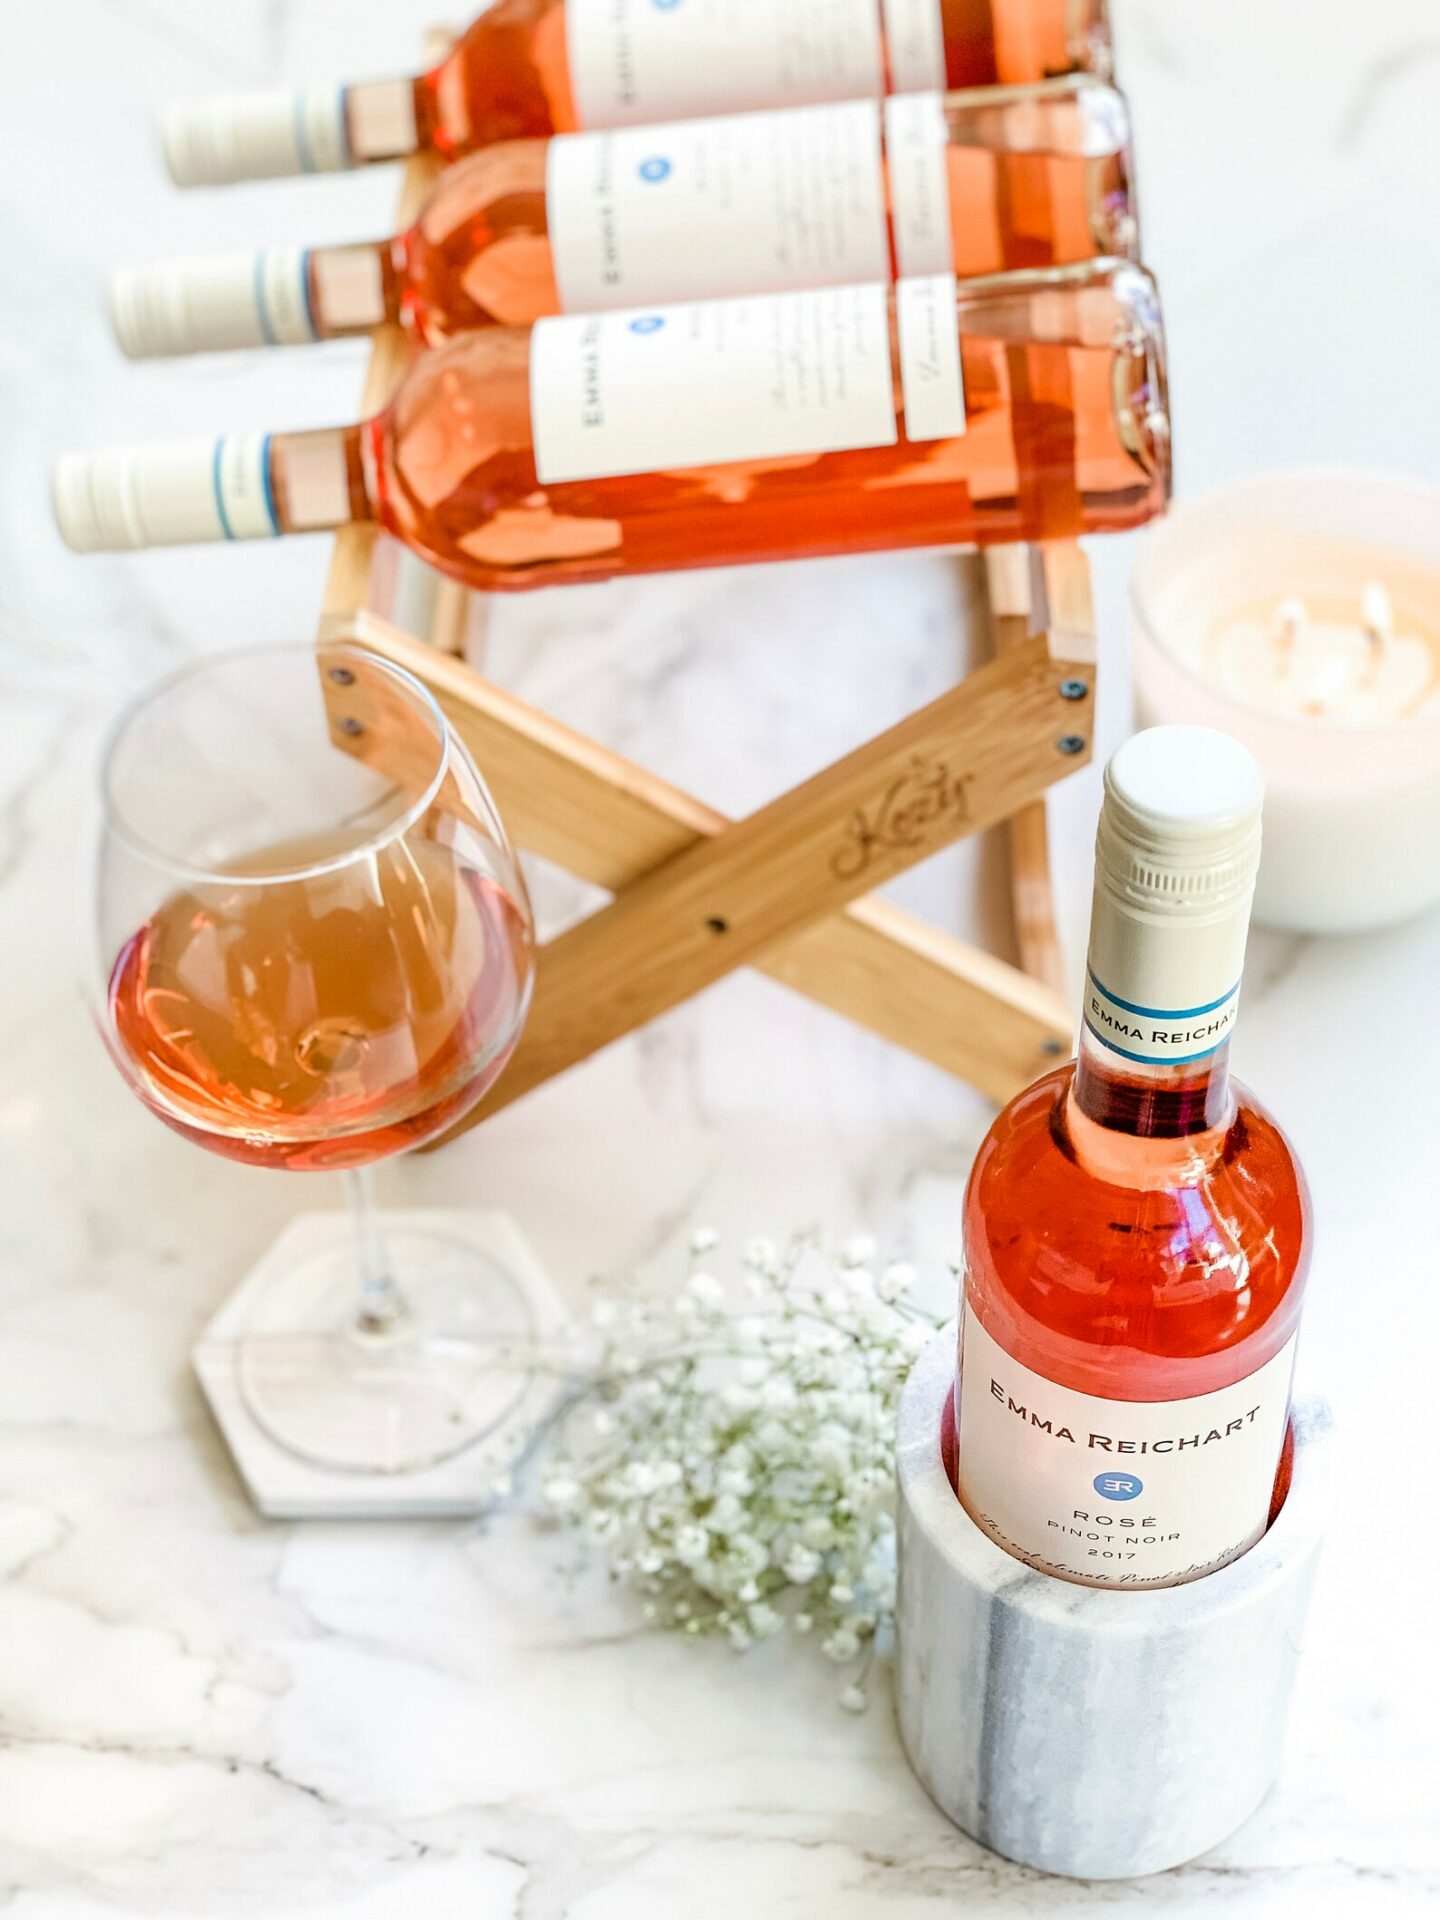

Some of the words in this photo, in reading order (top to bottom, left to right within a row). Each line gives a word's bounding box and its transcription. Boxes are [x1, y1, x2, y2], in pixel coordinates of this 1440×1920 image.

[1091, 997, 1143, 1041] EMMA
[989, 1377, 1077, 1445] EMMA
[1088, 1404, 1262, 1455] REICHART
[1047, 1519, 1116, 1545] PINOT
[1125, 1532, 1181, 1545] NOIR
[1072, 1509, 1159, 1529] ROSÉ
[1087, 1548, 1137, 1561] 2017
